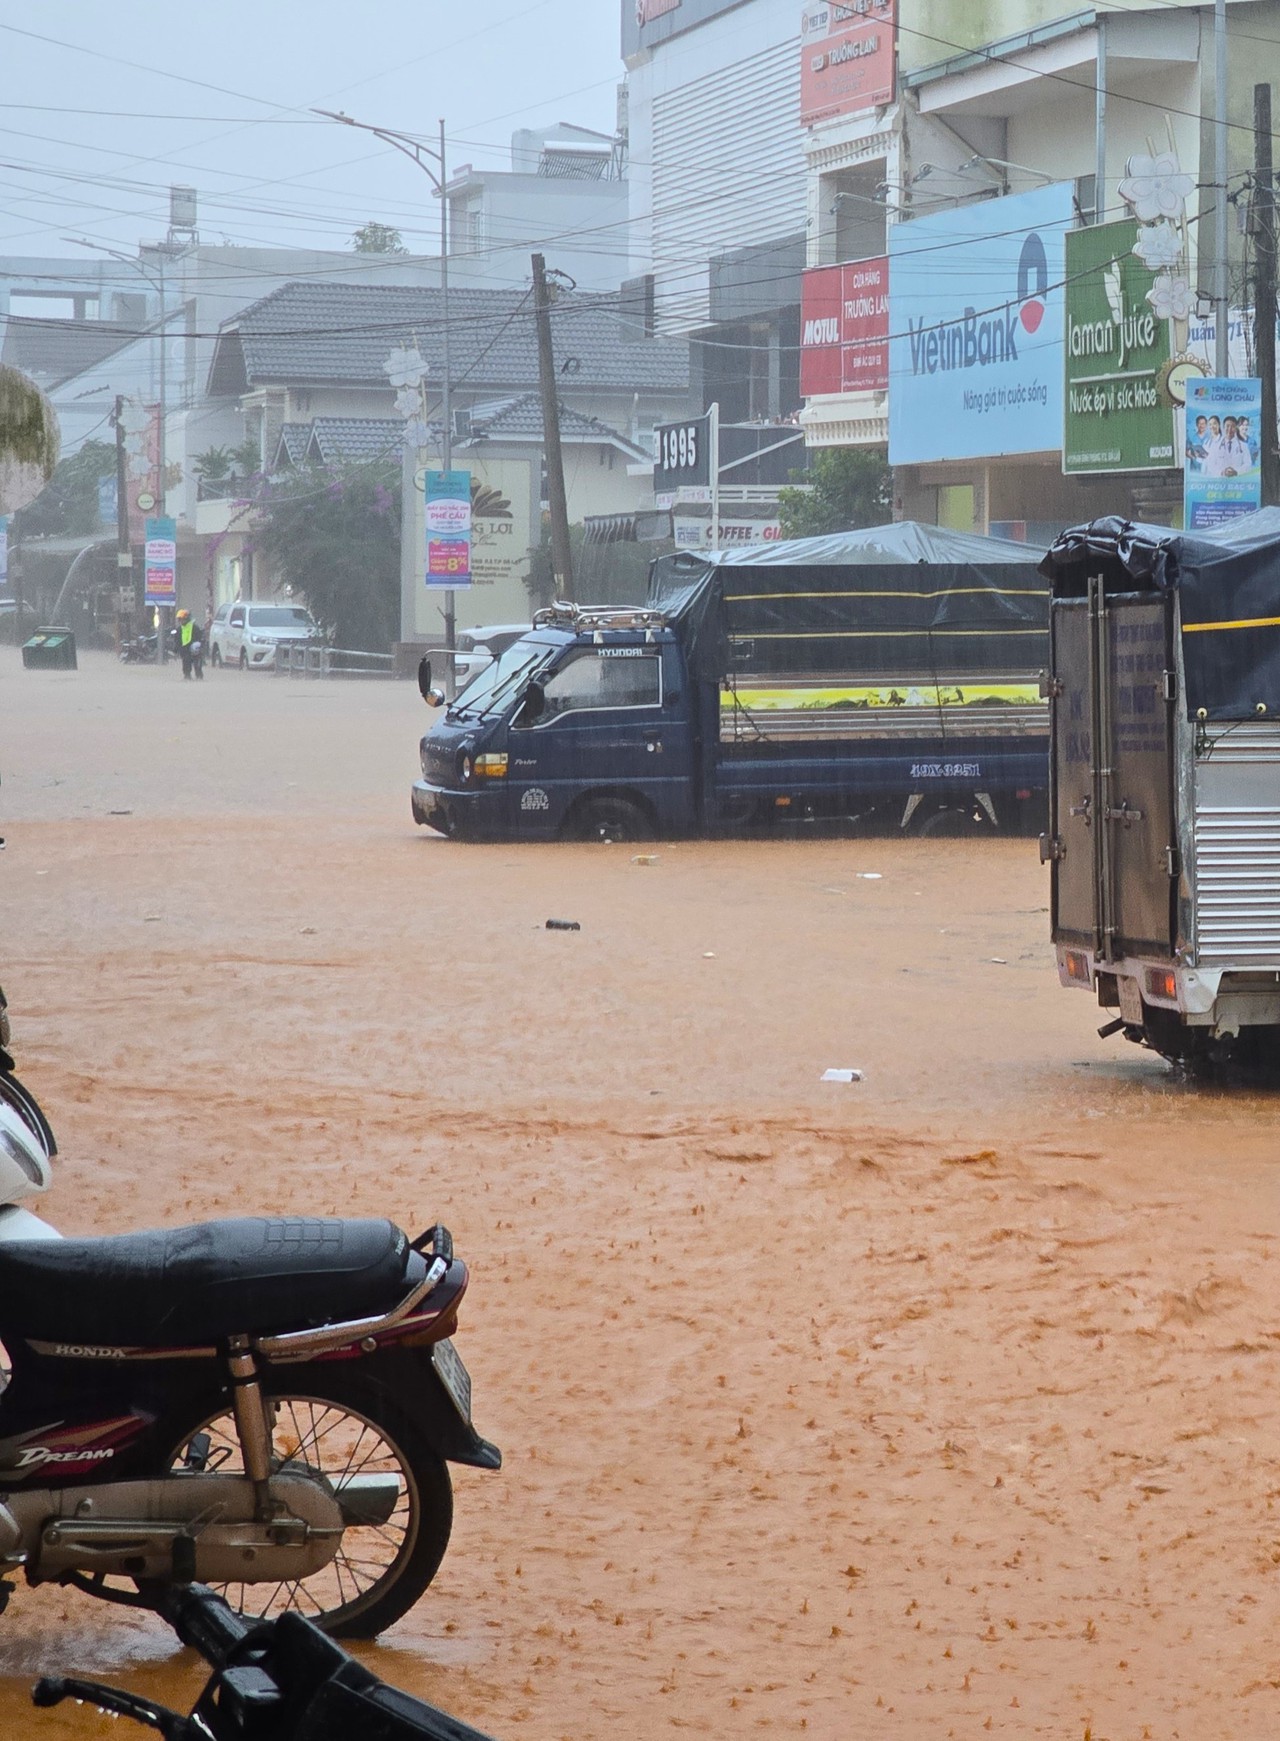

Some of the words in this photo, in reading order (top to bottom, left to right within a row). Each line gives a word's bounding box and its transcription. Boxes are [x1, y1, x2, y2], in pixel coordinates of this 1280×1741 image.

[844, 294, 874, 319] TRƯỜNG
[803, 318, 839, 346] MOTUL
[909, 300, 1018, 375] VietinBank
[1068, 314, 1113, 357] laman
[1118, 304, 1155, 367] juice
[963, 389, 982, 413] Nâng
[984, 386, 996, 412] giá
[1007, 383, 1026, 409] cuộc
[1028, 378, 1047, 405] sống
[1070, 388, 1092, 413] Nước
[1094, 387, 1106, 416] ép
[1118, 383, 1133, 410] sức
[1212, 394, 1232, 402] LONG
[1234, 392, 1254, 402] CHÂU
[663, 427, 696, 470] 1995
[489, 523, 513, 534] LỢI
[706, 526, 753, 540] COFFEE
[598, 648, 643, 657] HYUNDAI
[56, 1345, 125, 1358] HONDA
